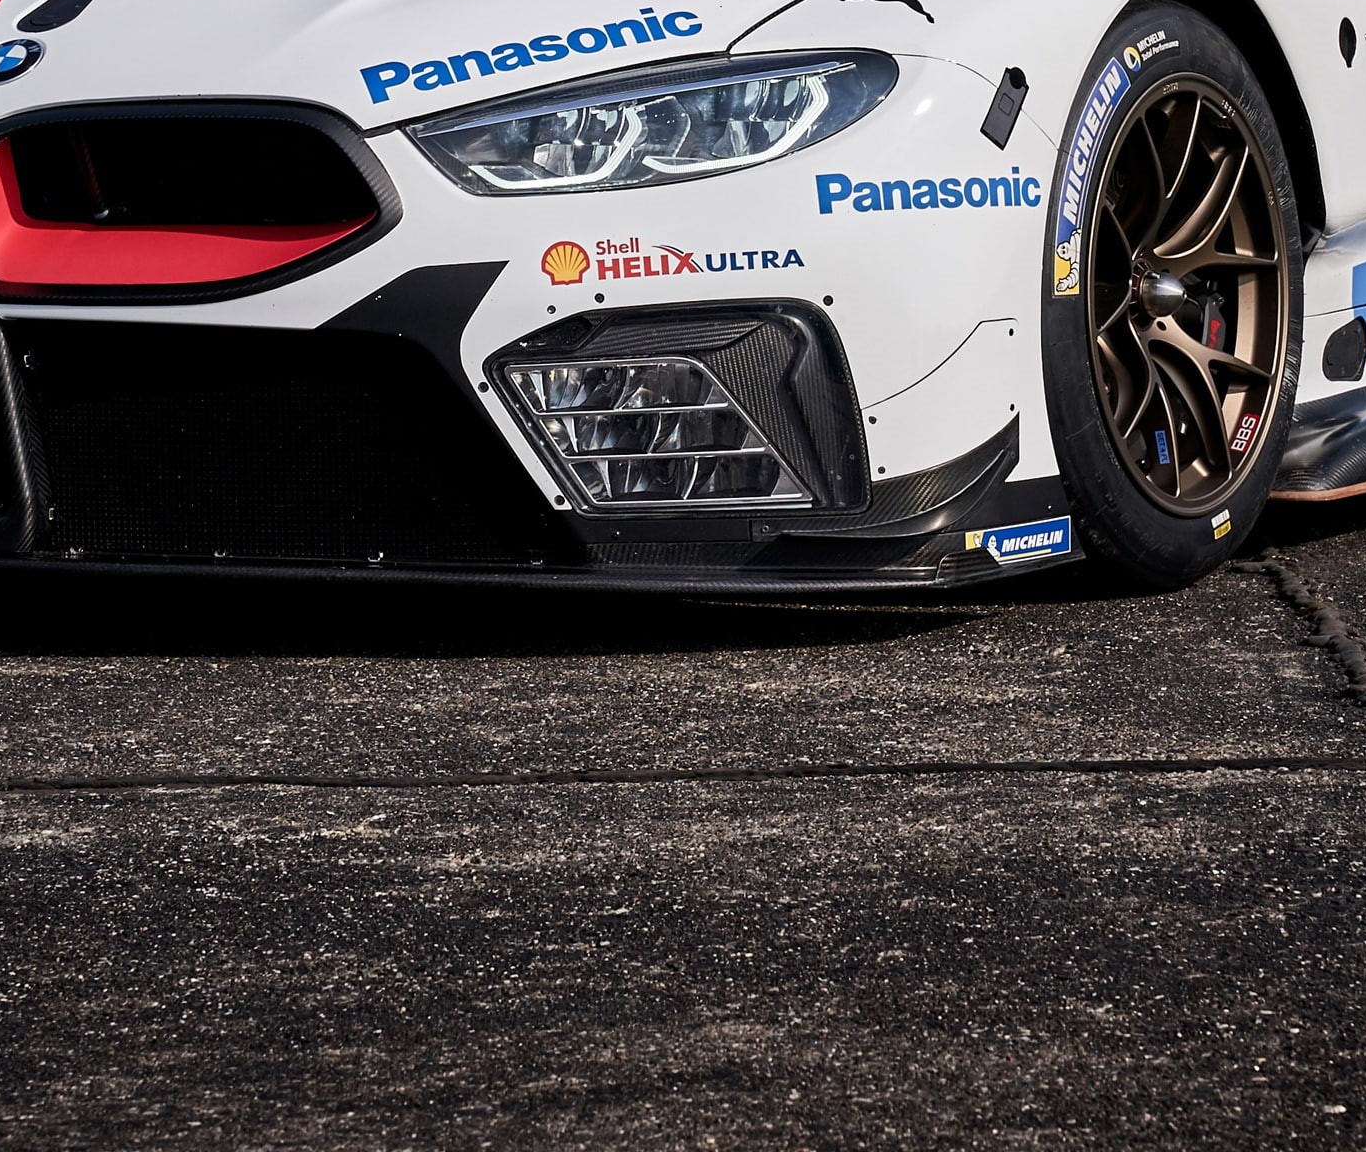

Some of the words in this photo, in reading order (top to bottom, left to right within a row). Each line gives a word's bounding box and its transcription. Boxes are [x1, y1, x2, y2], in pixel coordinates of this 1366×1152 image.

[359, 7, 703, 105] Panasonic
[1137, 30, 1166, 52] MICHELIN
[1063, 65, 1123, 224] MICHELIN
[816, 167, 1041, 214] Panasonic
[595, 237, 640, 256] Shell
[595, 251, 701, 280] HELIX
[705, 249, 805, 273] ULTRA
[1230, 415, 1257, 452] BBS
[1001, 530, 1063, 552] MICHELIN
